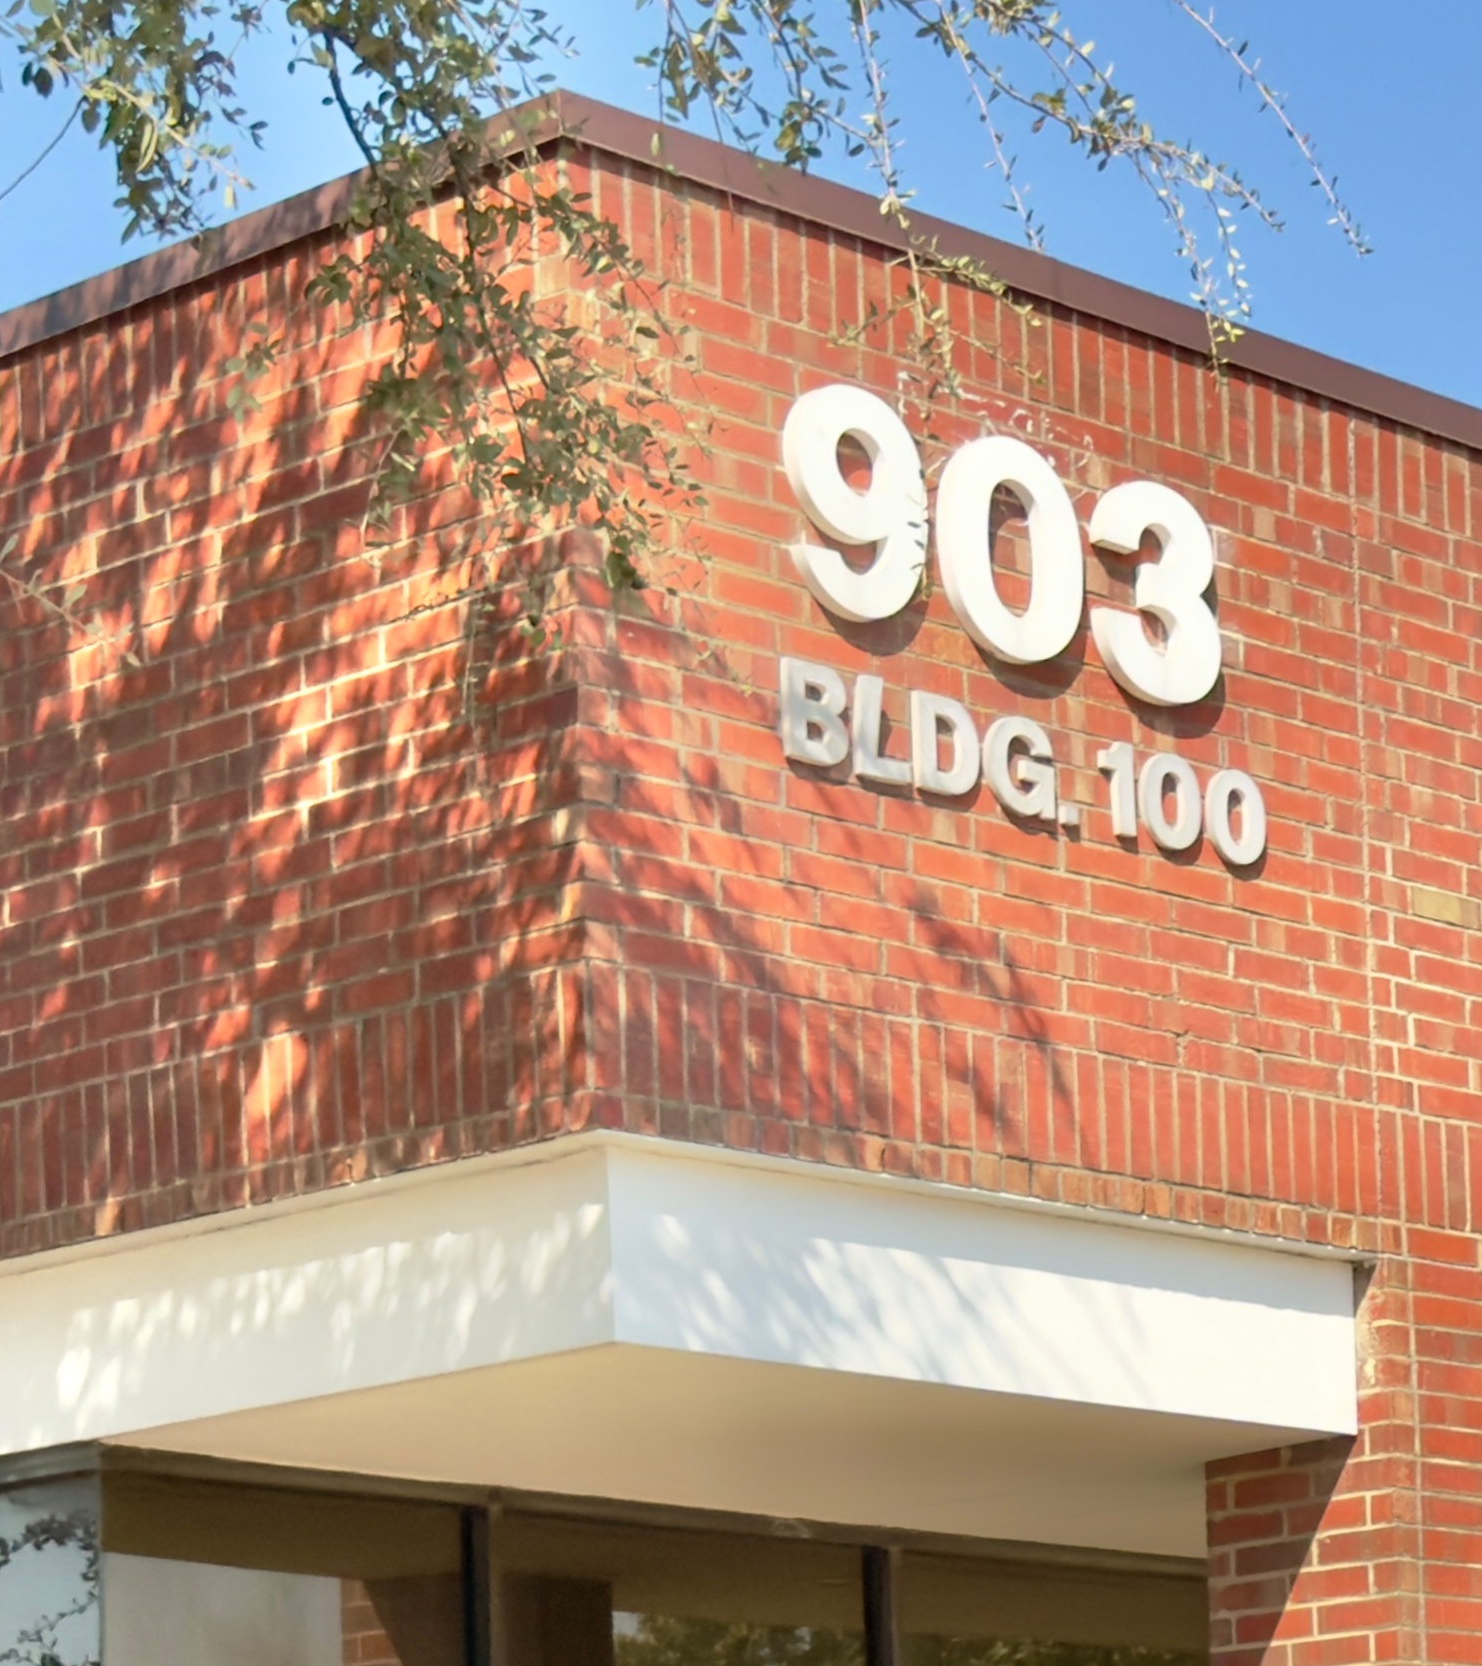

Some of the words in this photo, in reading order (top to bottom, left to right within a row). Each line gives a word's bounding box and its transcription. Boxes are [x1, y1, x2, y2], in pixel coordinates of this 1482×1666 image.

[782, 384, 1222, 707] 903
[780, 656, 1080, 828] BLDG.
[1097, 741, 1266, 866] 100
